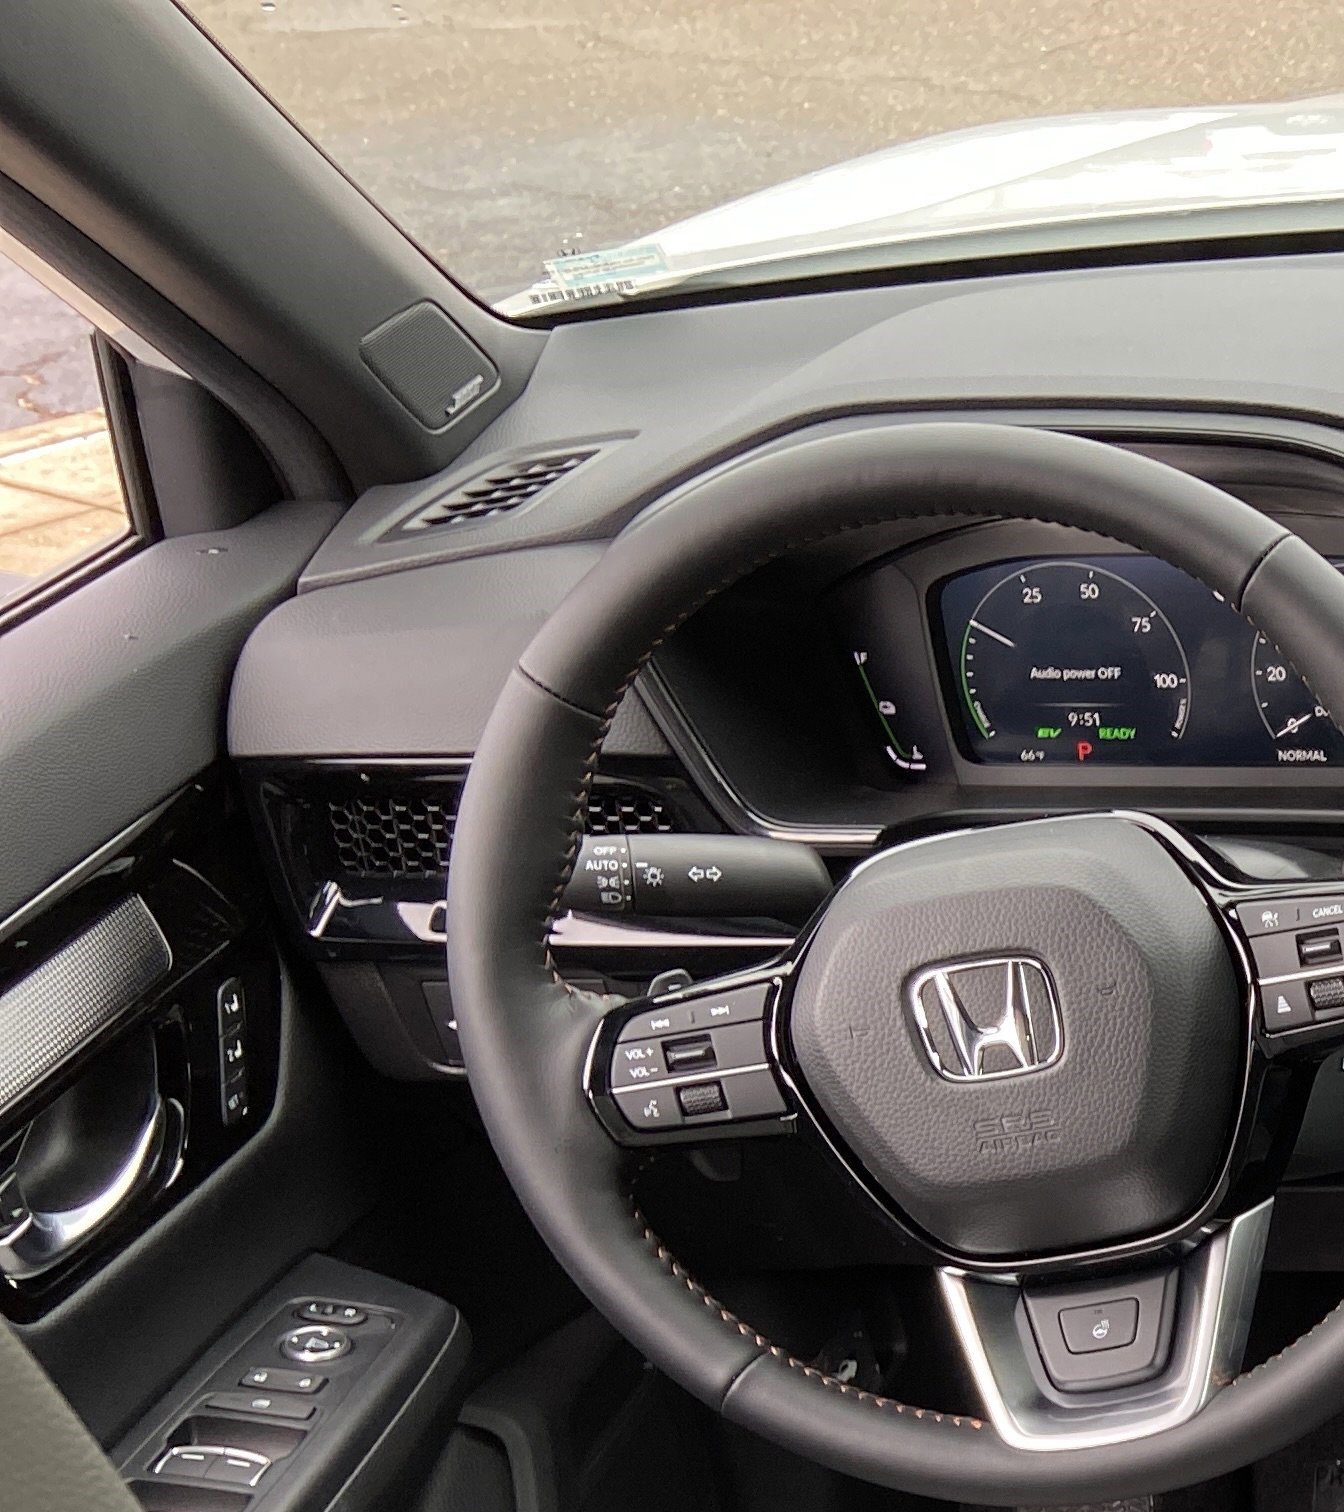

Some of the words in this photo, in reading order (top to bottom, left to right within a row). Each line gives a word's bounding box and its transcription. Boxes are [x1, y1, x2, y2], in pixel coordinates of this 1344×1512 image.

[1021, 587, 1043, 604] 25
[1079, 583, 1100, 600] 50
[1131, 616, 1151, 633] 75
[1030, 666, 1061, 680] Audio
[1063, 667, 1096, 682] power
[1097, 666, 1122, 679] OFF
[1153, 673, 1179, 689] 100
[1266, 666, 1286, 682] 20
[1067, 711, 1100, 727] 9:51
[1099, 726, 1137, 740] READY
[1076, 742, 1093, 761] P
[1277, 749, 1328, 762] NORMAL
[593, 845, 617, 856] OFF
[585, 859, 619, 872] AUTO
[1312, 904, 1344, 918] CANCEL
